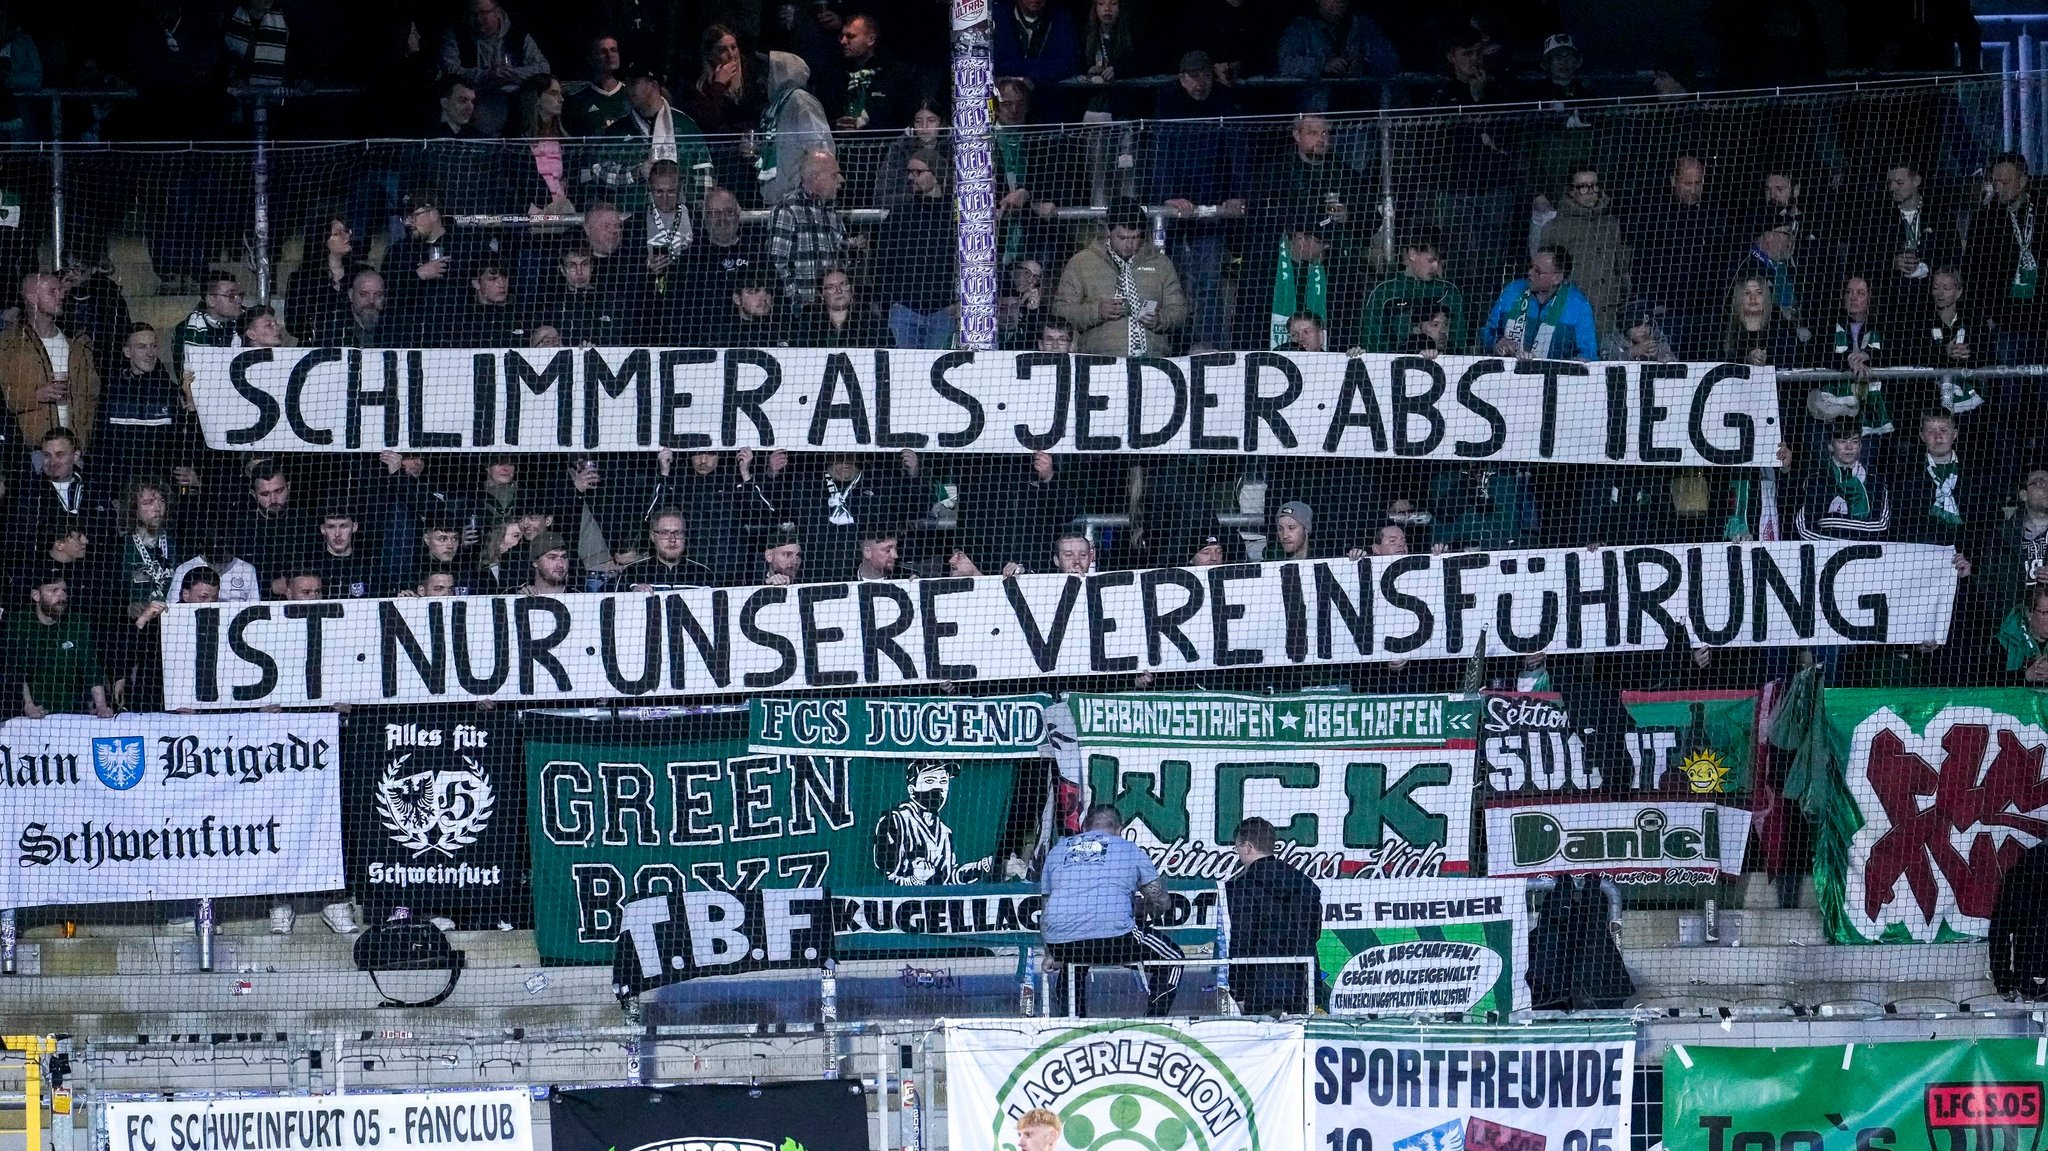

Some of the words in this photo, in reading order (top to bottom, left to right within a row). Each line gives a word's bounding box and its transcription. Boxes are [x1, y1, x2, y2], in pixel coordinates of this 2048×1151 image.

[226, 347, 782, 449] SCHLIMMER
[808, 350, 986, 449] ALS
[1014, 352, 1303, 452] JEDER
[1323, 355, 1755, 465] ABSTIEG
[195, 602, 344, 701] IST
[379, 596, 573, 698] NUR
[600, 577, 978, 696] UNSERE
[1004, 543, 1889, 673] VEREINSFÜHRUNG
[385, 723, 443, 750] Alles
[453, 724, 489, 751] für
[761, 698, 850, 745] FCS
[865, 699, 1048, 746] JUGEND
[1078, 698, 1275, 738] VERBANDSSTRAFEN
[1303, 700, 1442, 738] ABSCHAFFEN
[158, 733, 330, 786] Brigade
[540, 755, 854, 847] GREEN
[1088, 754, 1452, 848] WCK
[18, 815, 281, 870] Schweinfurt
[1353, 838, 1446, 879] Kids
[1511, 808, 1721, 867] Daniel
[368, 861, 500, 888] Schweinfurt
[1615, 871, 1661, 885] unseren
[1665, 867, 1718, 886] Herzen!
[1375, 896, 1503, 921] FOREVER
[620, 887, 823, 979] T.B.F.
[1359, 949, 1386, 970] USK
[1388, 943, 1481, 963] ABSCHAFFEN!
[1341, 970, 1382, 987] GEGEN
[1384, 965, 1481, 985] POLIZEIGEWALT!
[1314, 1046, 1625, 1109] SPORTFREUNDE
[127, 1114, 156, 1151] FC
[171, 1109, 345, 1151] SCHWEINFURT
[353, 1109, 379, 1147] 05
[405, 1104, 514, 1145] FANCLUB
[1934, 1093, 2036, 1118] 1.FC.S.05
